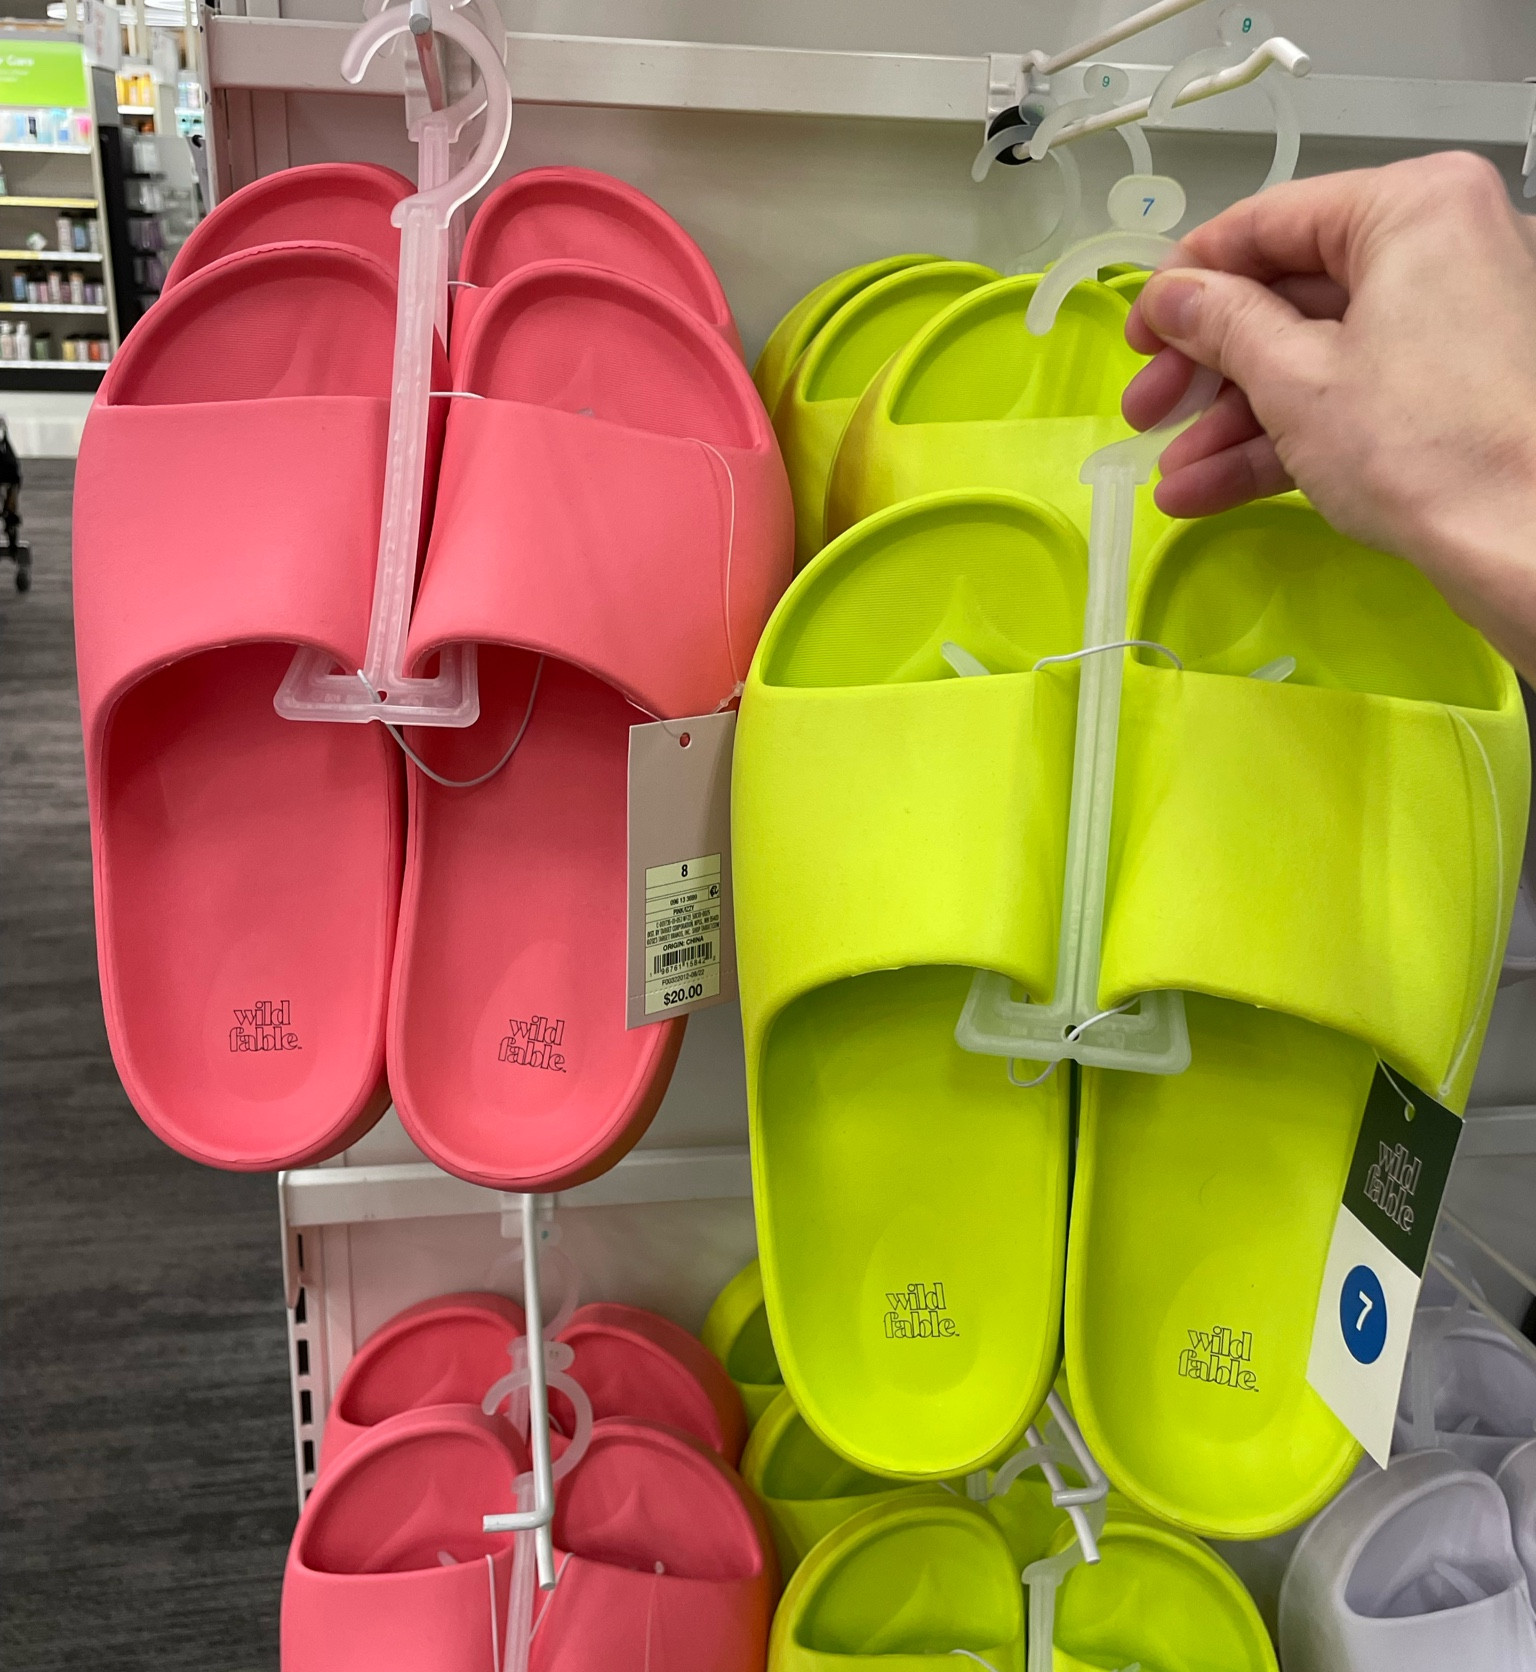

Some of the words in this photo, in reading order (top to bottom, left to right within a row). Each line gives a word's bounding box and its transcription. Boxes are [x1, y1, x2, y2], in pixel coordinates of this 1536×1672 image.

[1242, 17, 1252, 33] 9
[1102, 75, 1110, 87] 9
[1142, 197, 1155, 216] 7
[681, 864, 688, 878] 8
[662, 940, 685, 951] ORIGIN:
[685, 935, 704, 945] CHINA
[686, 957, 706, 968] 15842
[663, 983, 703, 1006] $20.00
[233, 1000, 291, 1026] wild
[509, 1015, 565, 1046] wild
[1378, 1140, 1423, 1196] wild
[885, 1282, 947, 1311] wild
[1355, 1290, 1374, 1332] 7
[1187, 1325, 1252, 1361] wild
